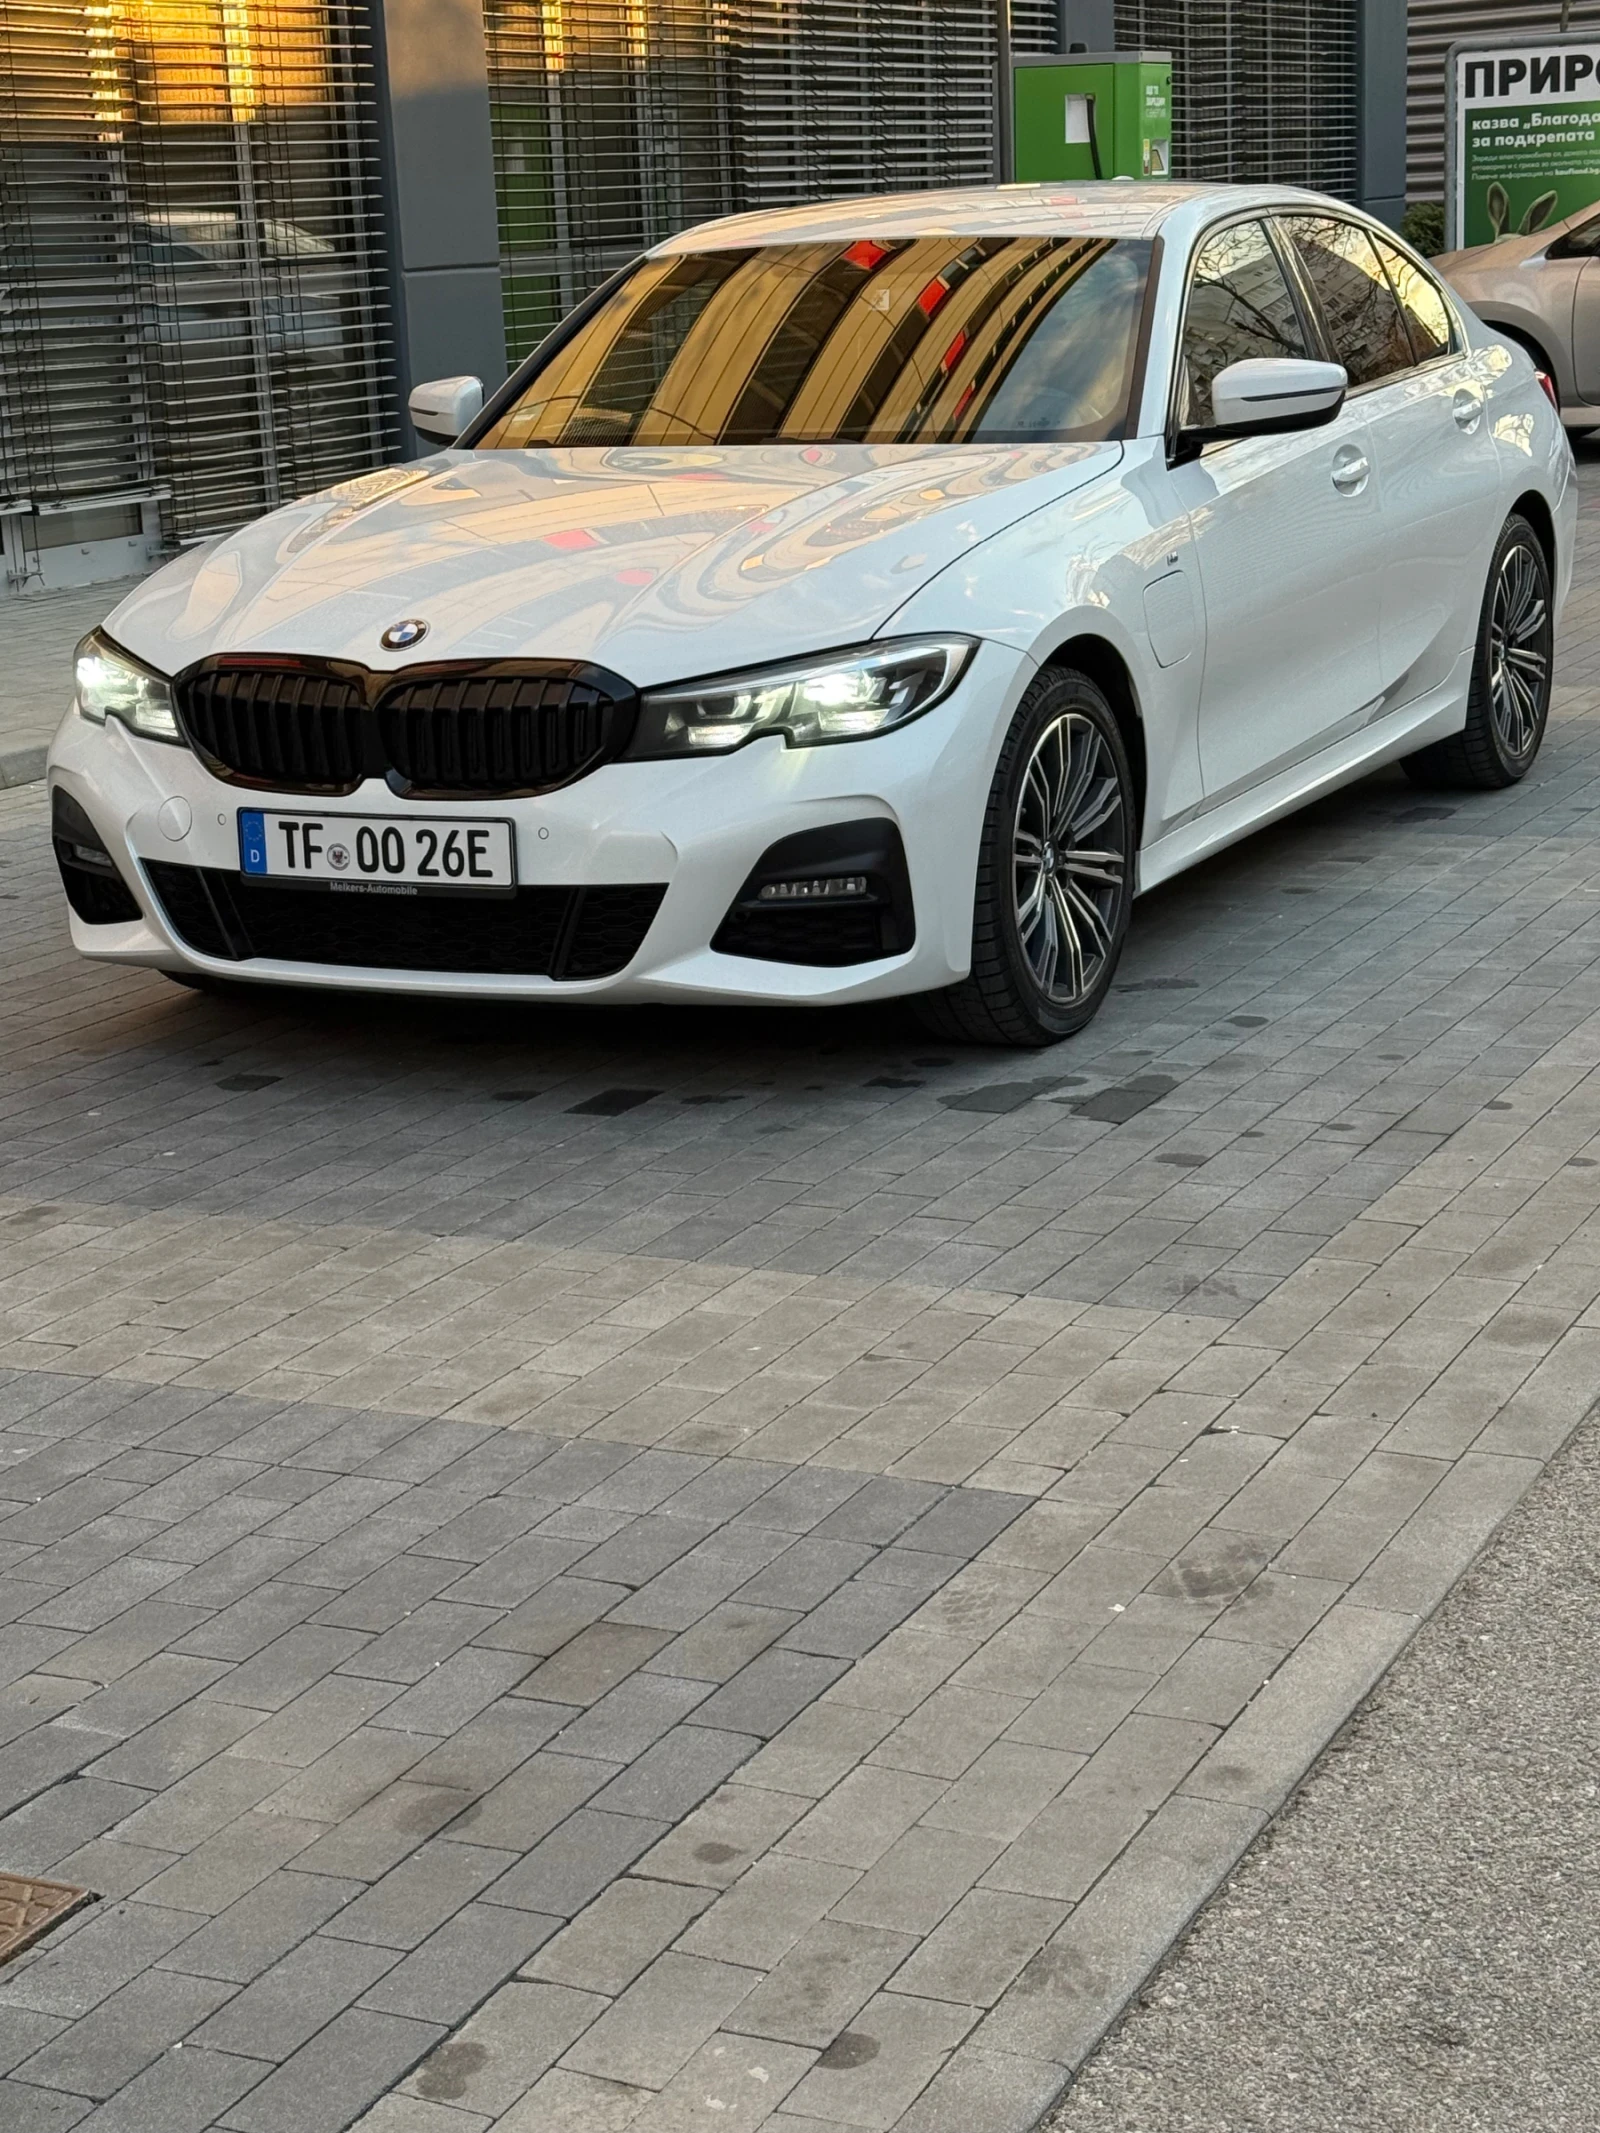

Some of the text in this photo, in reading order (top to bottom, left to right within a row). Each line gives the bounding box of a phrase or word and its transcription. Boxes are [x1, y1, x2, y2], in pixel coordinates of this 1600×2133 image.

[1465, 54, 1600, 98] ПРИР
[1472, 117, 1519, 130] казва
[1472, 130, 1595, 148] за подкрепата
[250, 849, 261, 863] D
[278, 821, 323, 869] TF
[415, 829, 493, 878] 26E
